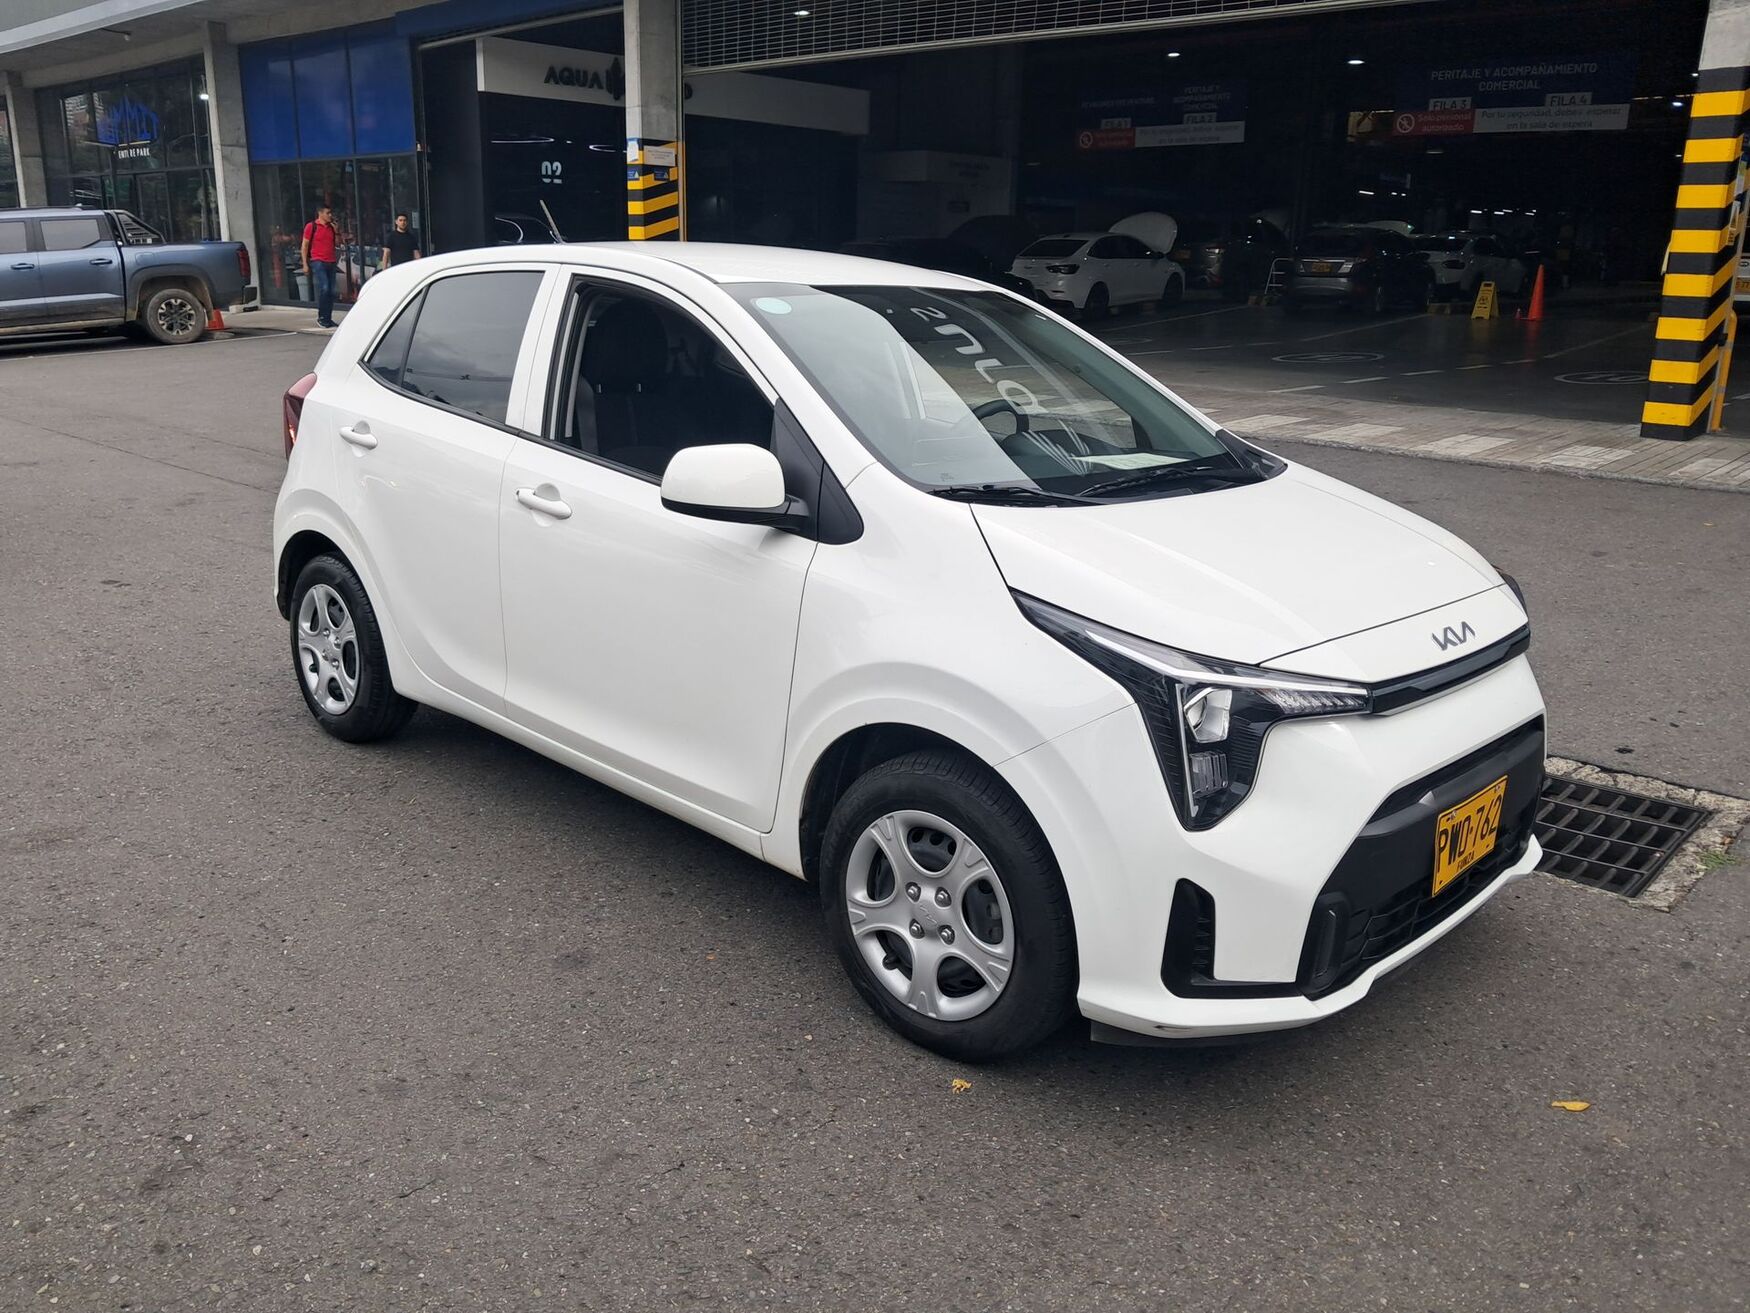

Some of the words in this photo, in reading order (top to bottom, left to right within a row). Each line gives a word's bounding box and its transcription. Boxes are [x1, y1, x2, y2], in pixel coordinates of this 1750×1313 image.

[544, 65, 604, 90] AQUA
[1430, 68, 1481, 81] PERITAJE
[1484, 68, 1493, 78] Y
[1493, 62, 1598, 78] ACOMPAÑAMIENTO
[1479, 79, 1541, 92] COMERCIAL
[1433, 100, 1457, 111] FILA
[1550, 95, 1577, 107] FILA
[1579, 94, 1588, 104] 4
[541, 161, 563, 184] 02
[1431, 621, 1476, 651] KIA
